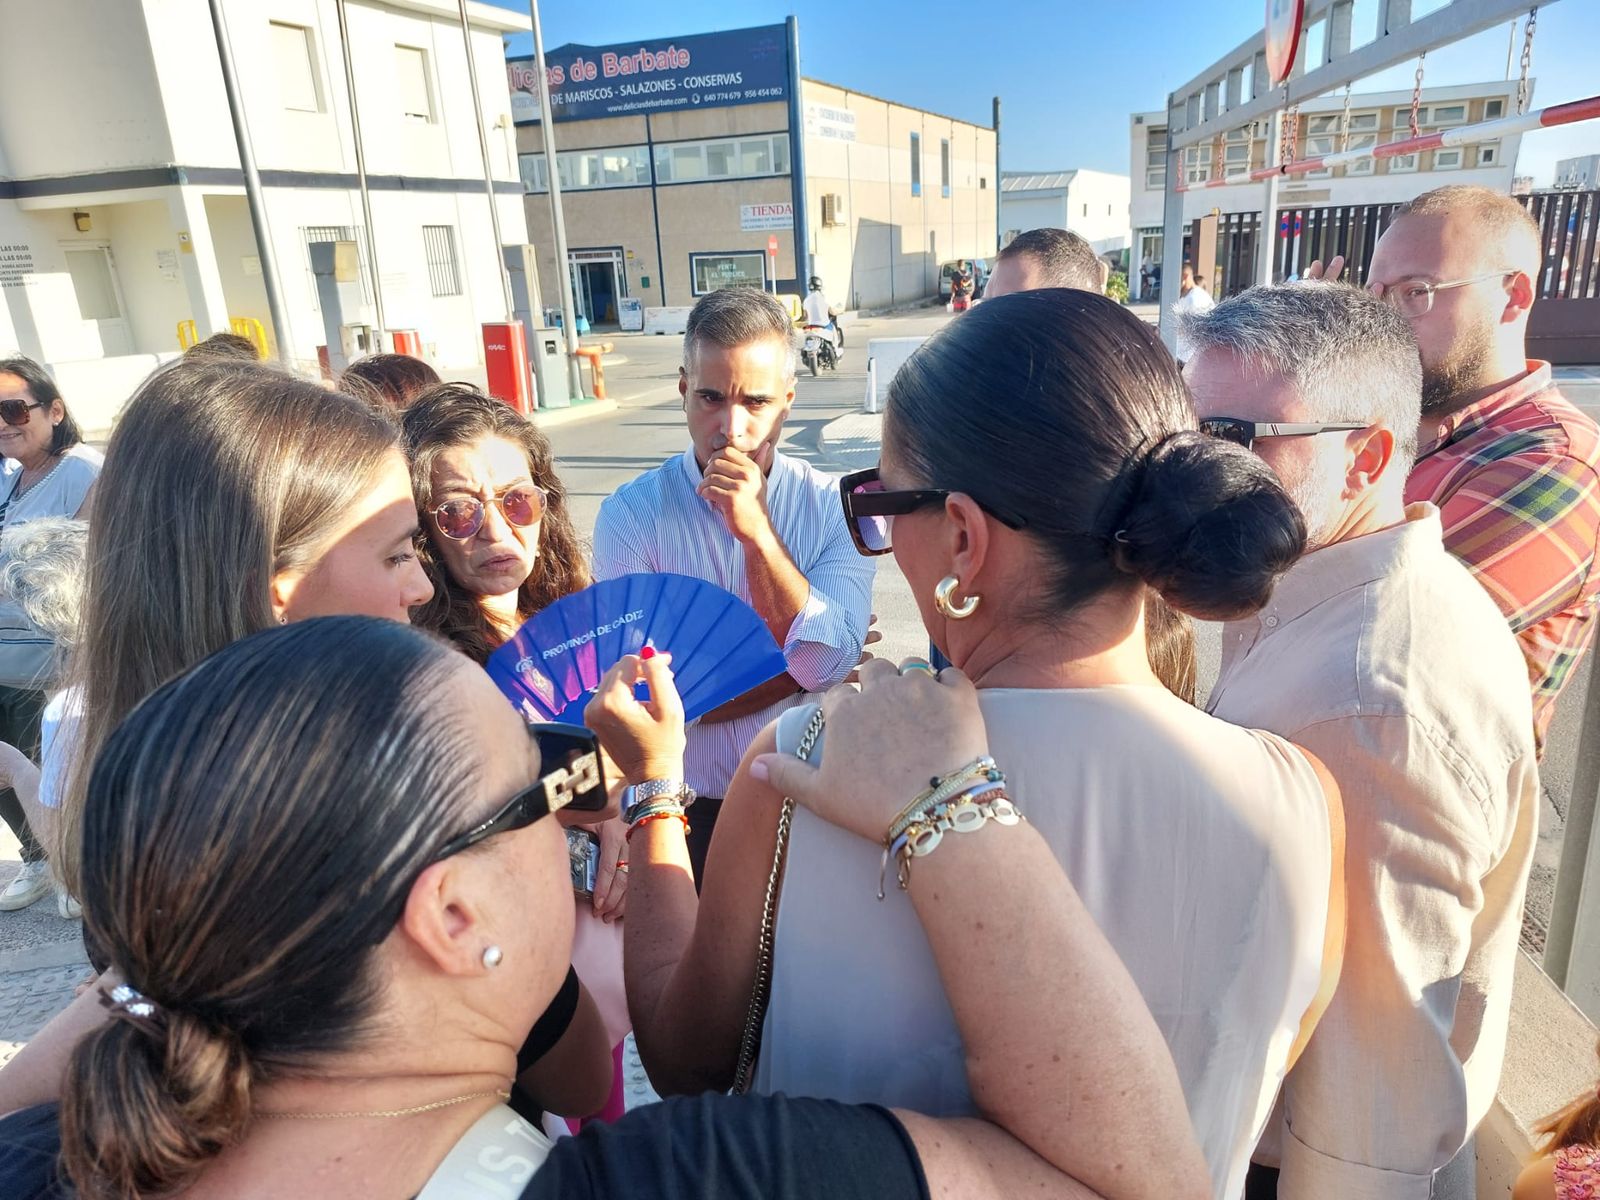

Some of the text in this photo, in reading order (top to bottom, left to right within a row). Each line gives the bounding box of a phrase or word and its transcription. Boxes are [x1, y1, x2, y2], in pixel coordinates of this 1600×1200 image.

[570, 57, 597, 82] de
[602, 48, 690, 78] Barbate
[551, 92, 563, 105] DE
[565, 86, 613, 104] MARISCOS
[620, 78, 676, 97] SALAZONES
[683, 71, 743, 89] CONSERVAS
[750, 204, 793, 216] TIENDA
[542, 629, 597, 660] PROVINCIA
[597, 624, 612, 636] DE
